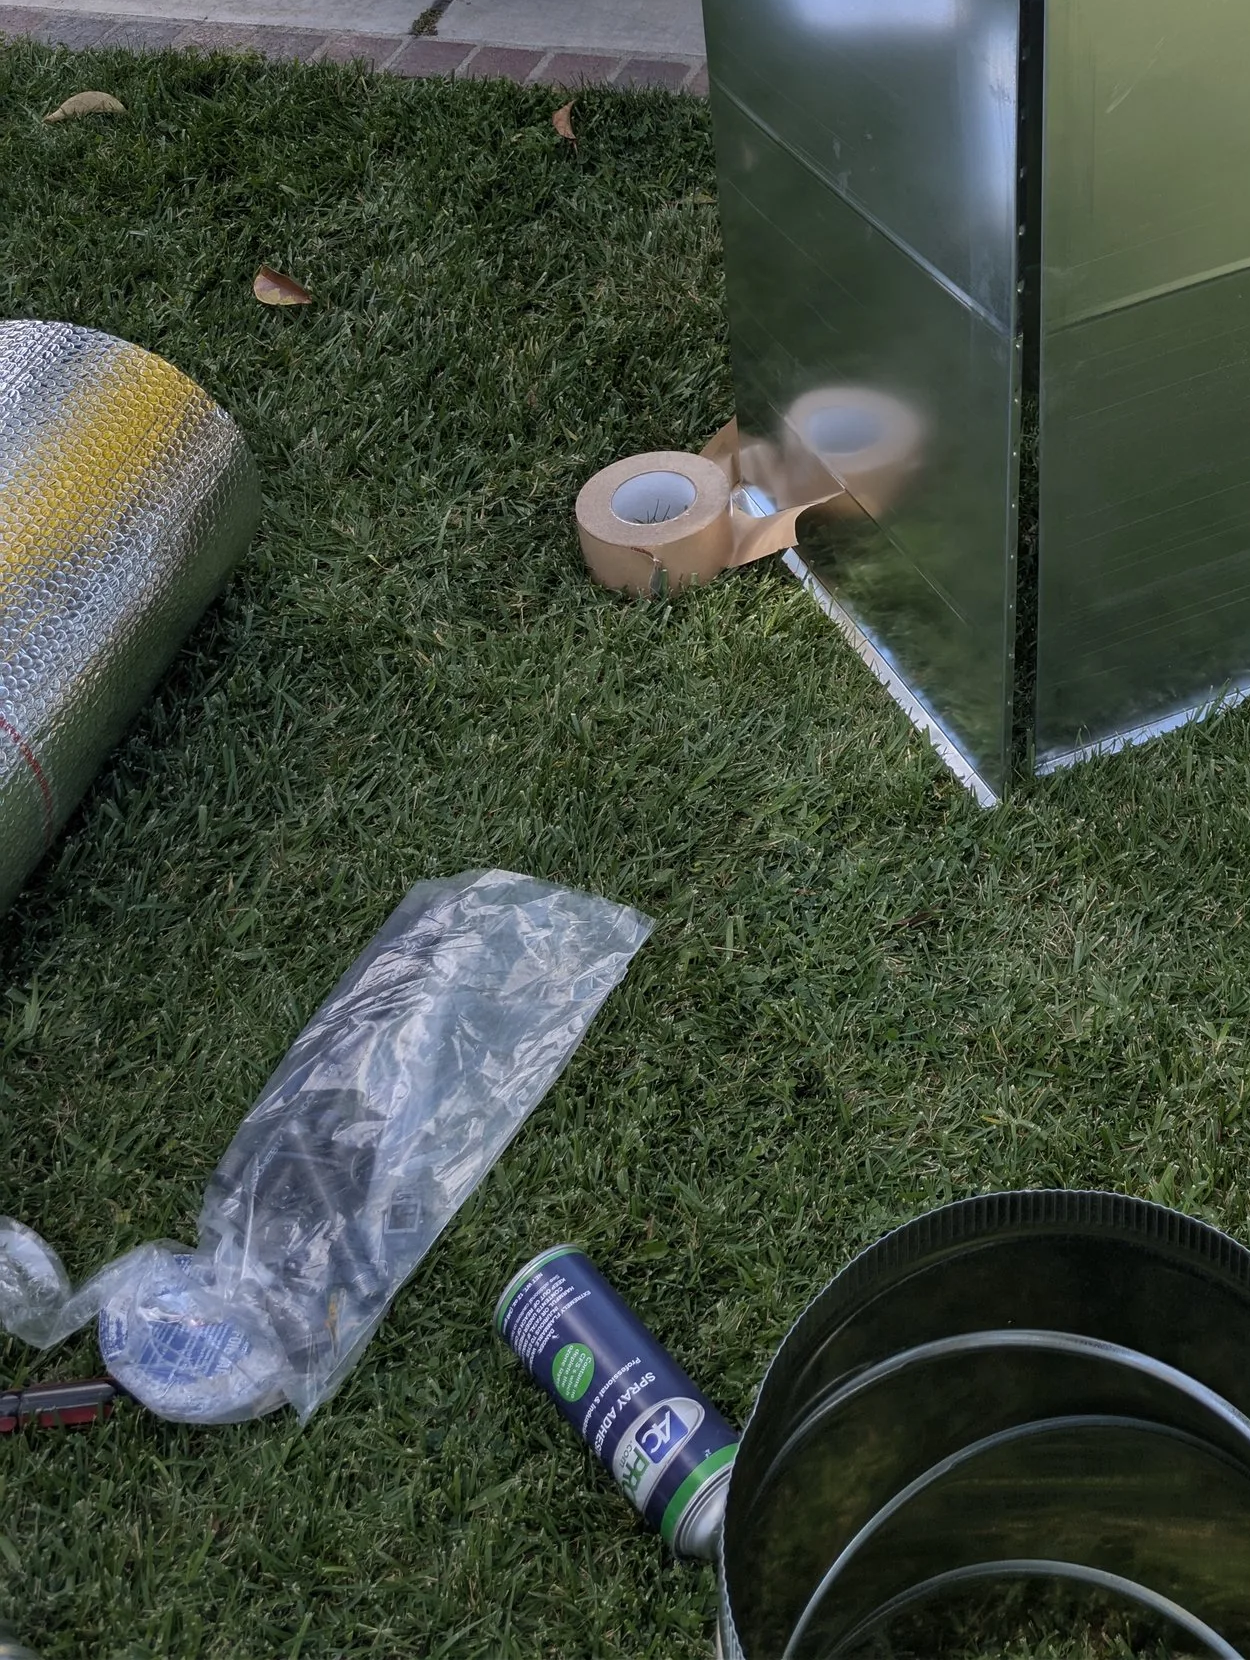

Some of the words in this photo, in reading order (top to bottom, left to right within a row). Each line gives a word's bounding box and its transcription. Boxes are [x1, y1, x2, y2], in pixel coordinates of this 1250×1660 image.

[531, 1272, 543, 1283] NET
[548, 1274, 560, 1283] See
[550, 1277, 566, 1290] KEEP
[516, 1291, 523, 1300] 12
[532, 1298, 540, 1309] OF
[535, 1286, 563, 1313] CONTENTS
[538, 1288, 551, 1300] OUT
[547, 1285, 575, 1308] HARMFUL
[559, 1290, 591, 1314] EXTREMELY
[519, 1307, 534, 1328] REACH
[534, 1305, 558, 1335] INJURIOUS
[540, 1306, 549, 1316] OR
[523, 1312, 537, 1333] UNDER
[528, 1315, 542, 1333] FATAL
[530, 1334, 536, 1344] TO
[560, 1344, 574, 1365] ozone
[564, 1348, 580, 1373] deplete
[572, 1355, 592, 1388] Contains
[598, 1356, 641, 1397] Professional
[593, 1395, 600, 1404] &
[618, 1371, 656, 1411] SPRAY
[639, 1410, 670, 1455] AC
